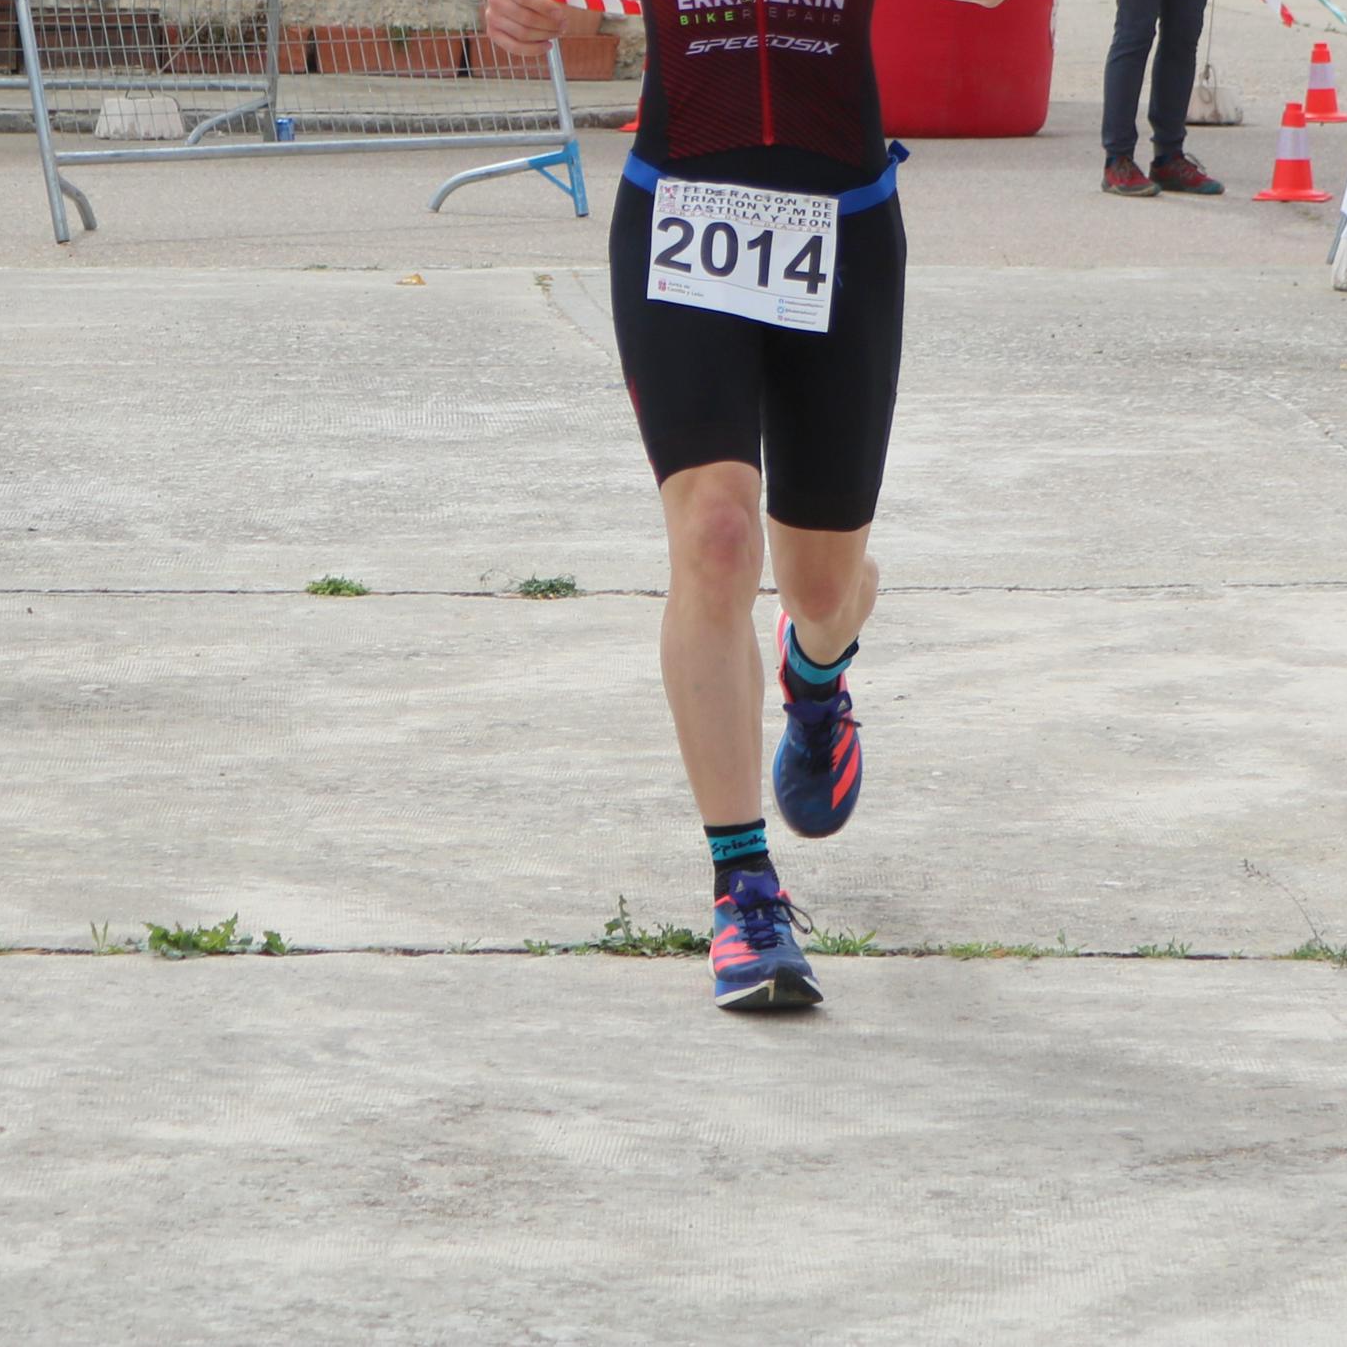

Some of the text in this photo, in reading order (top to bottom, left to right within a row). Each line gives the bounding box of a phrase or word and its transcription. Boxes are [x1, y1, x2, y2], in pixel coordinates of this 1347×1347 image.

[680, 7, 841, 26] BIKE REPAIR
[685, 34, 839, 55] SPEEDSIX
[681, 203, 832, 229] CASTILLA Y LEON
[682, 195, 757, 210] TRIATLON
[763, 203, 773, 213] Y
[812, 209, 832, 220] DE
[812, 200, 832, 210] DE
[654, 217, 827, 294] 2014
